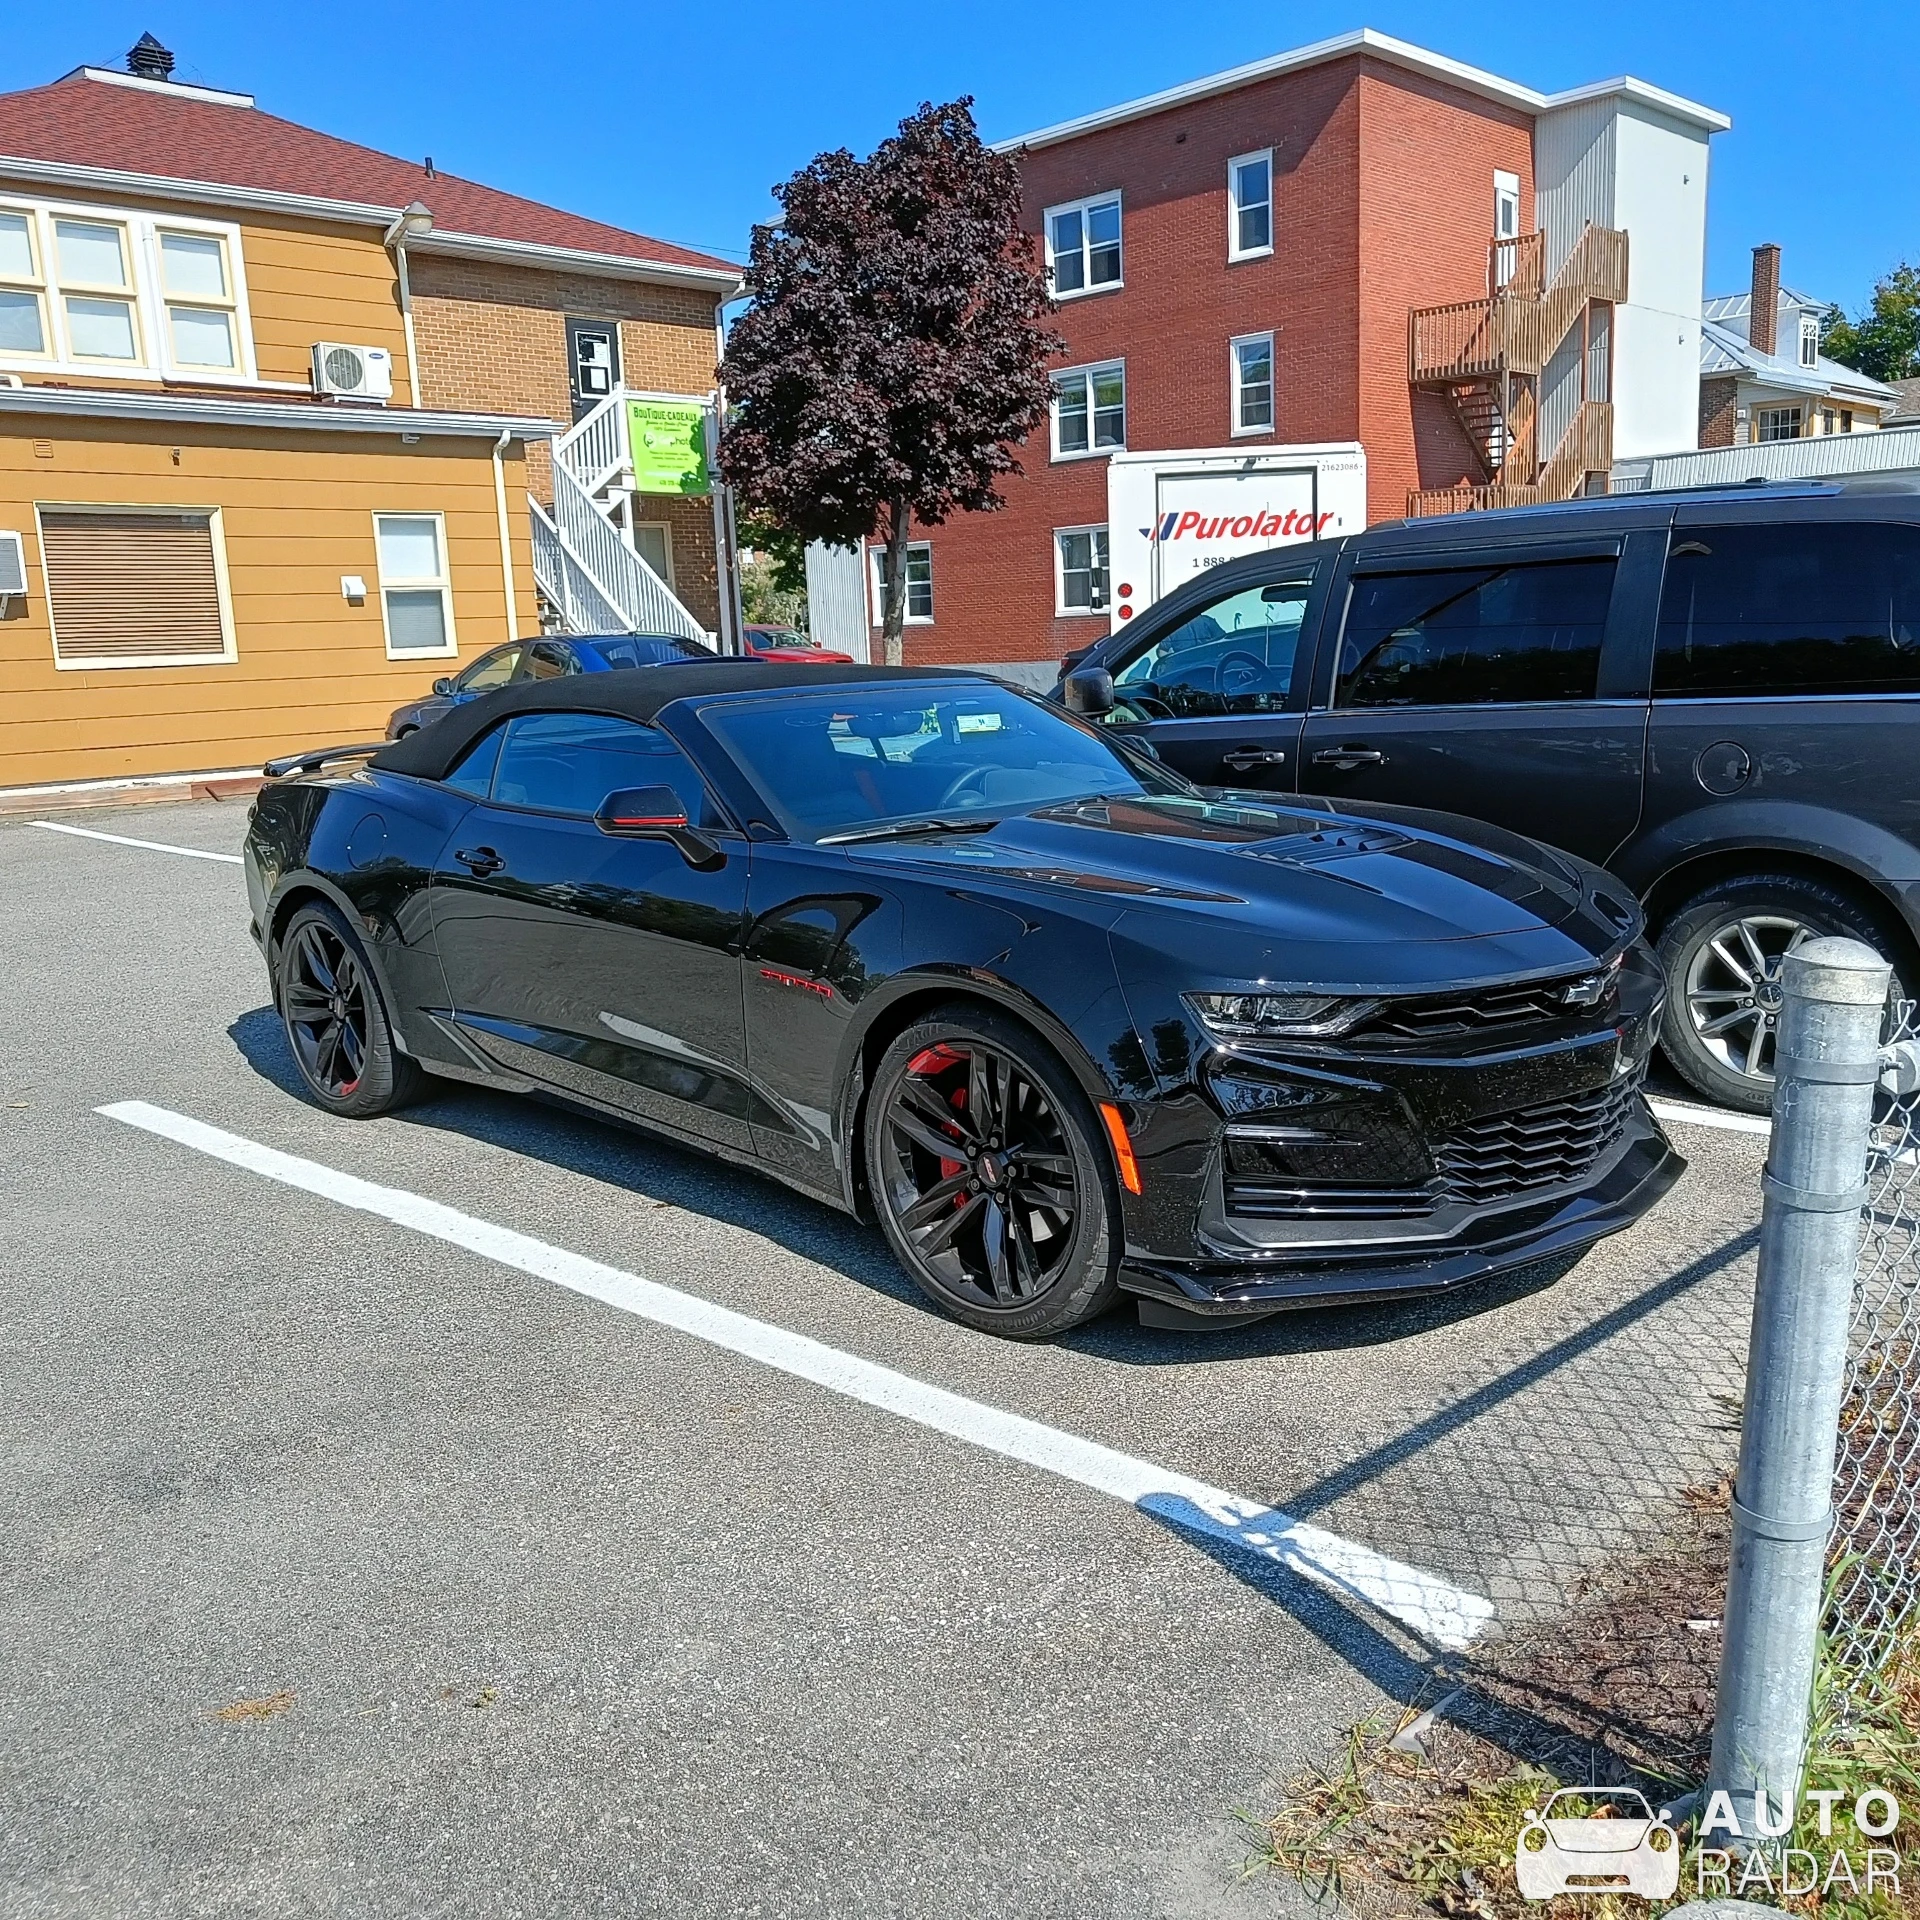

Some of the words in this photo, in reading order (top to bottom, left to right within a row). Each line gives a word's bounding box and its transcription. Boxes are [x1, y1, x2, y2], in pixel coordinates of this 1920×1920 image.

[1321, 463, 1359, 472] 21623086
[1173, 508, 1335, 540] Purolator
[1192, 557, 1200, 568] 1
[1203, 556, 1225, 568] 888
